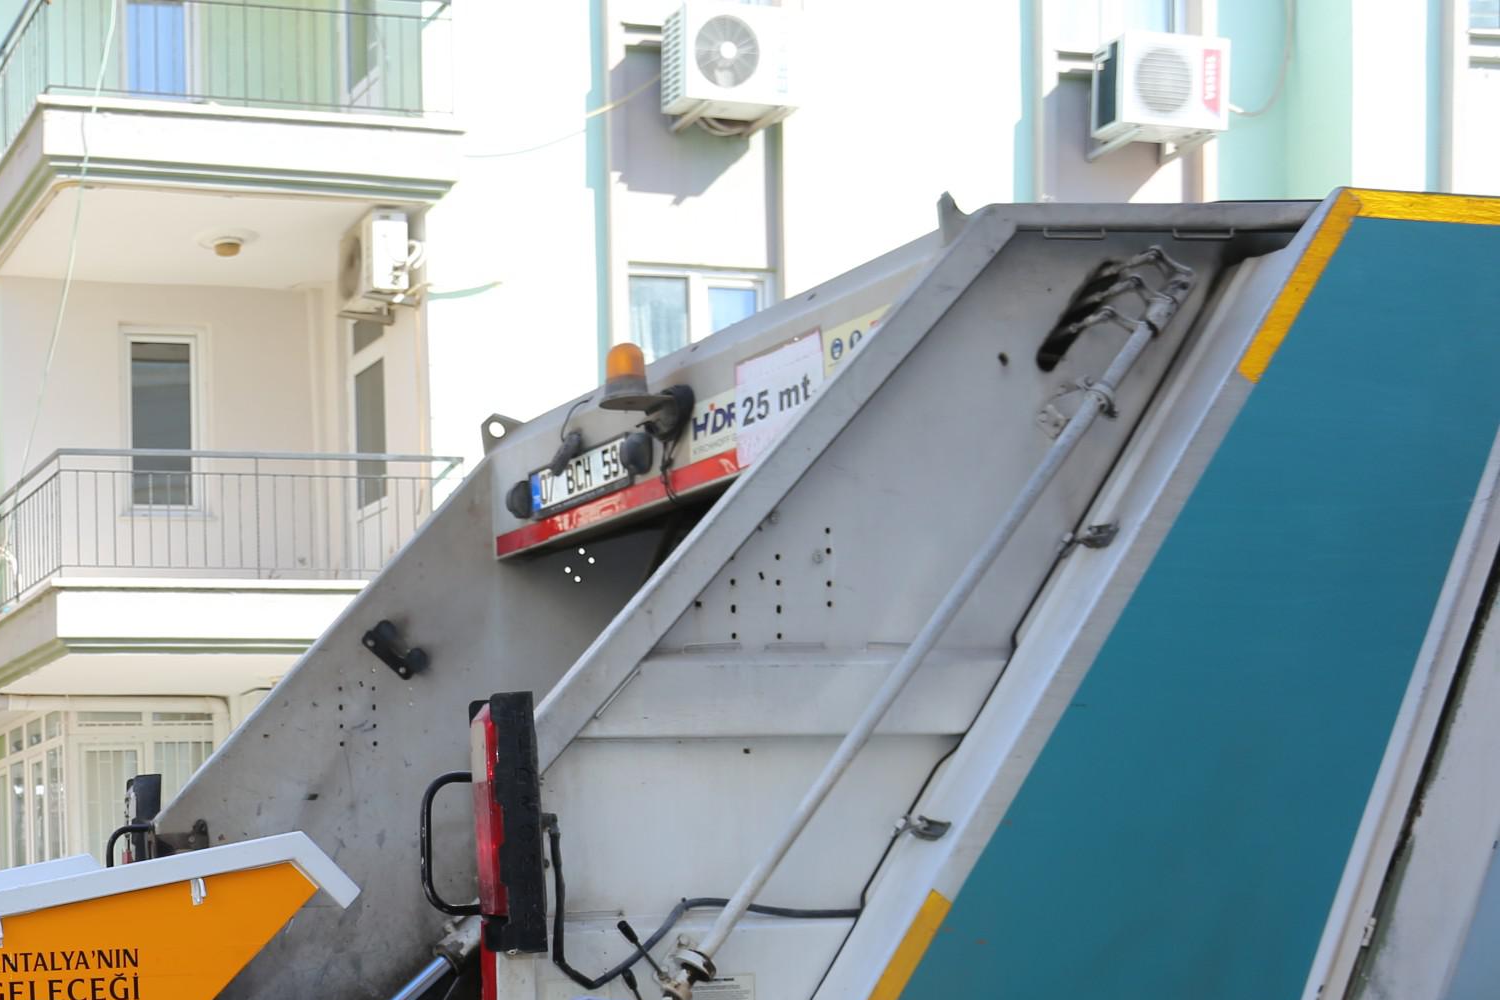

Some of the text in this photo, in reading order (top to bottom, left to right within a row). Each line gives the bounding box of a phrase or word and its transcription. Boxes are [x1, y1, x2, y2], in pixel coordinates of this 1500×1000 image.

[742, 373, 811, 427] 25 mt
[566, 455, 593, 495] BCH
[601, 443, 624, 481] 59
